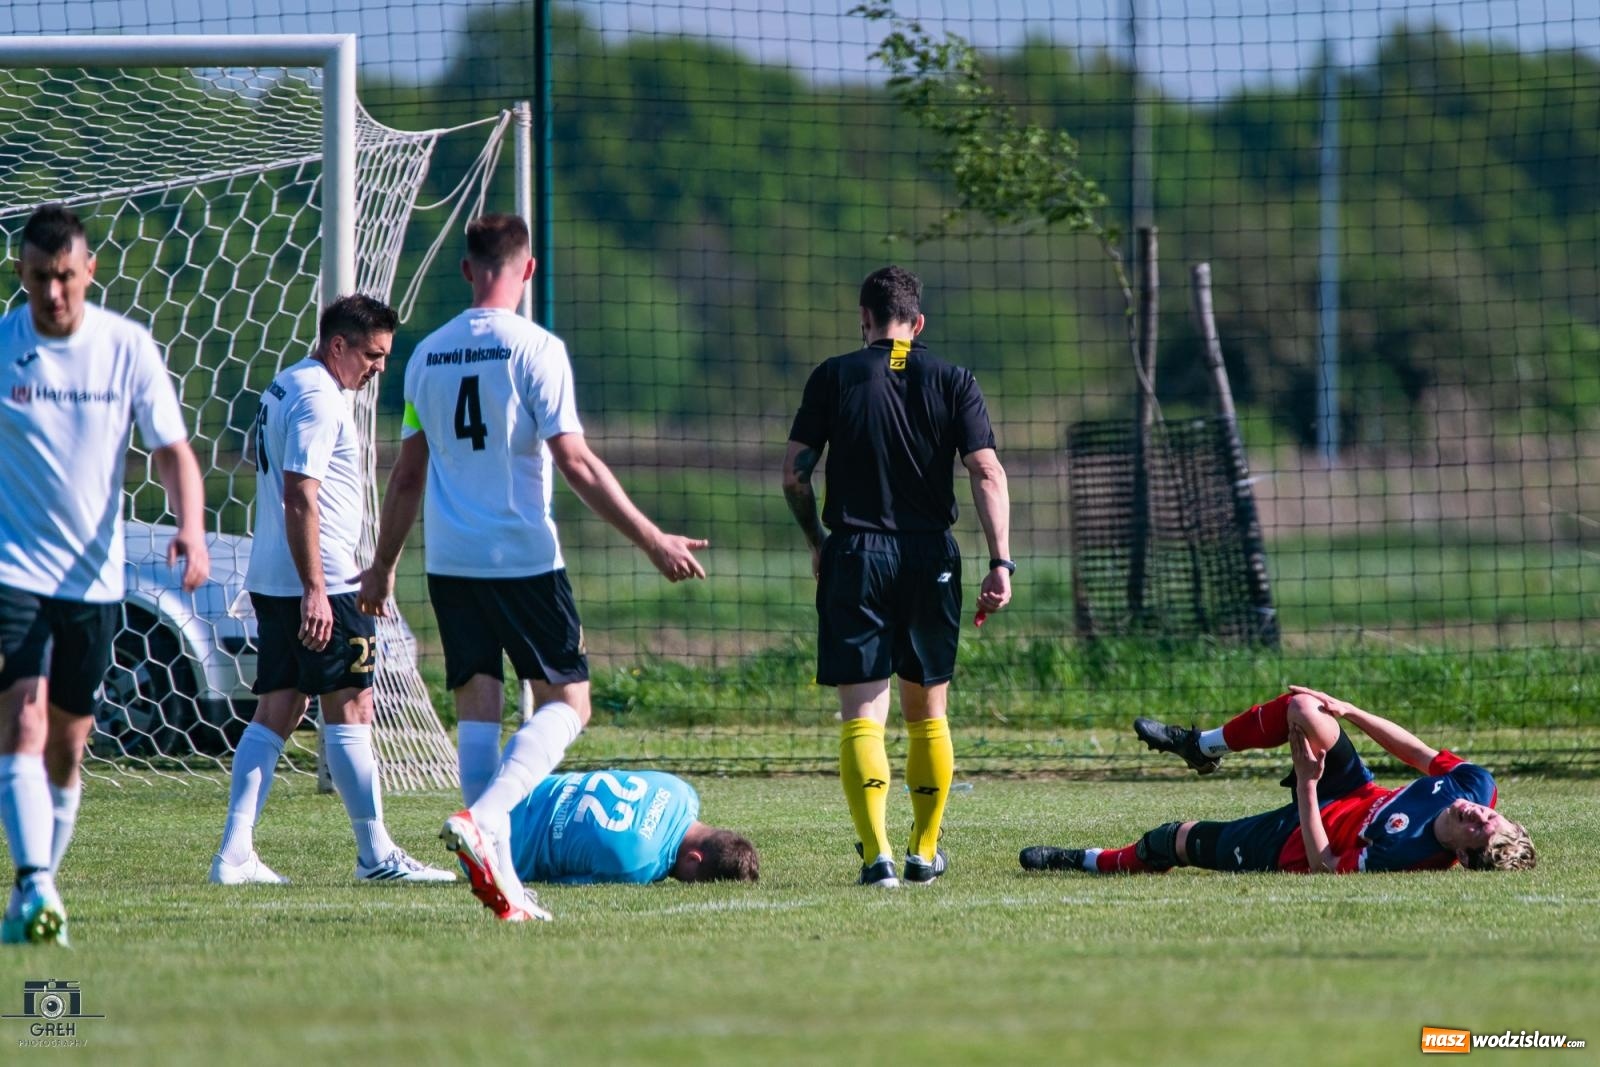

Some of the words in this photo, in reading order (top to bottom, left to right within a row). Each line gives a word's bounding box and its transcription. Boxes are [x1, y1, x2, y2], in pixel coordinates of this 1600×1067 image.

[426, 348, 463, 367] Rozwój
[454, 375, 488, 451] 4
[573, 772, 648, 832] 22
